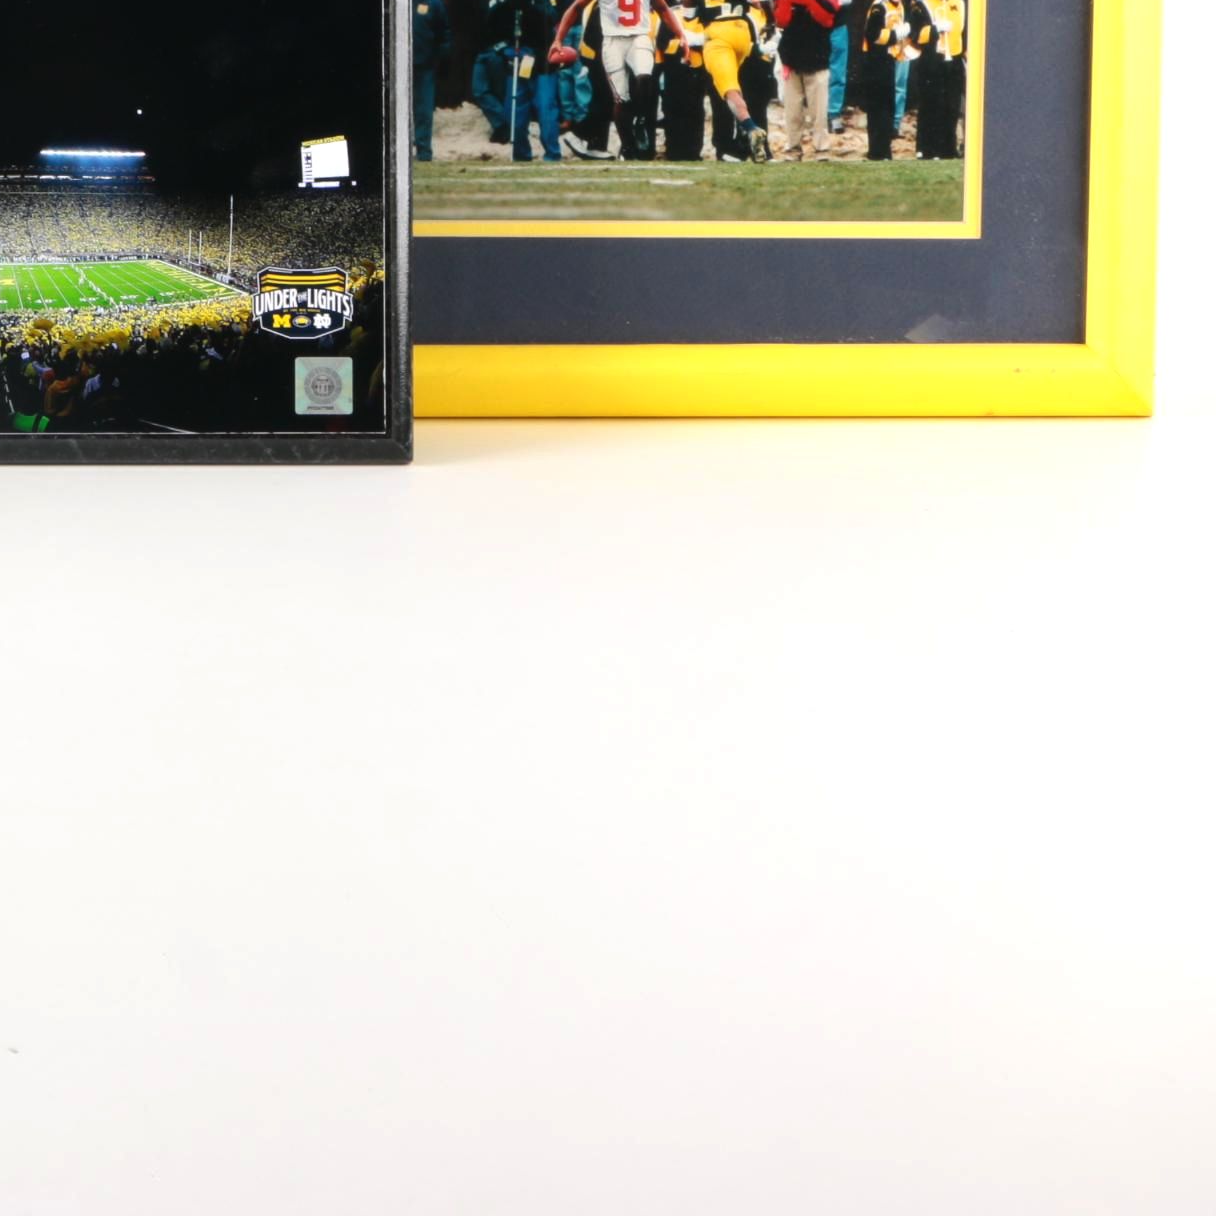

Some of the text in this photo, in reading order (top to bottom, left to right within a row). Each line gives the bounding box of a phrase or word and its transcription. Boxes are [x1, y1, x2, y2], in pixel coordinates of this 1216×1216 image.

[255, 288, 298, 316] UNDER
[307, 288, 350, 317] LIGHTS
[272, 313, 292, 328] M
